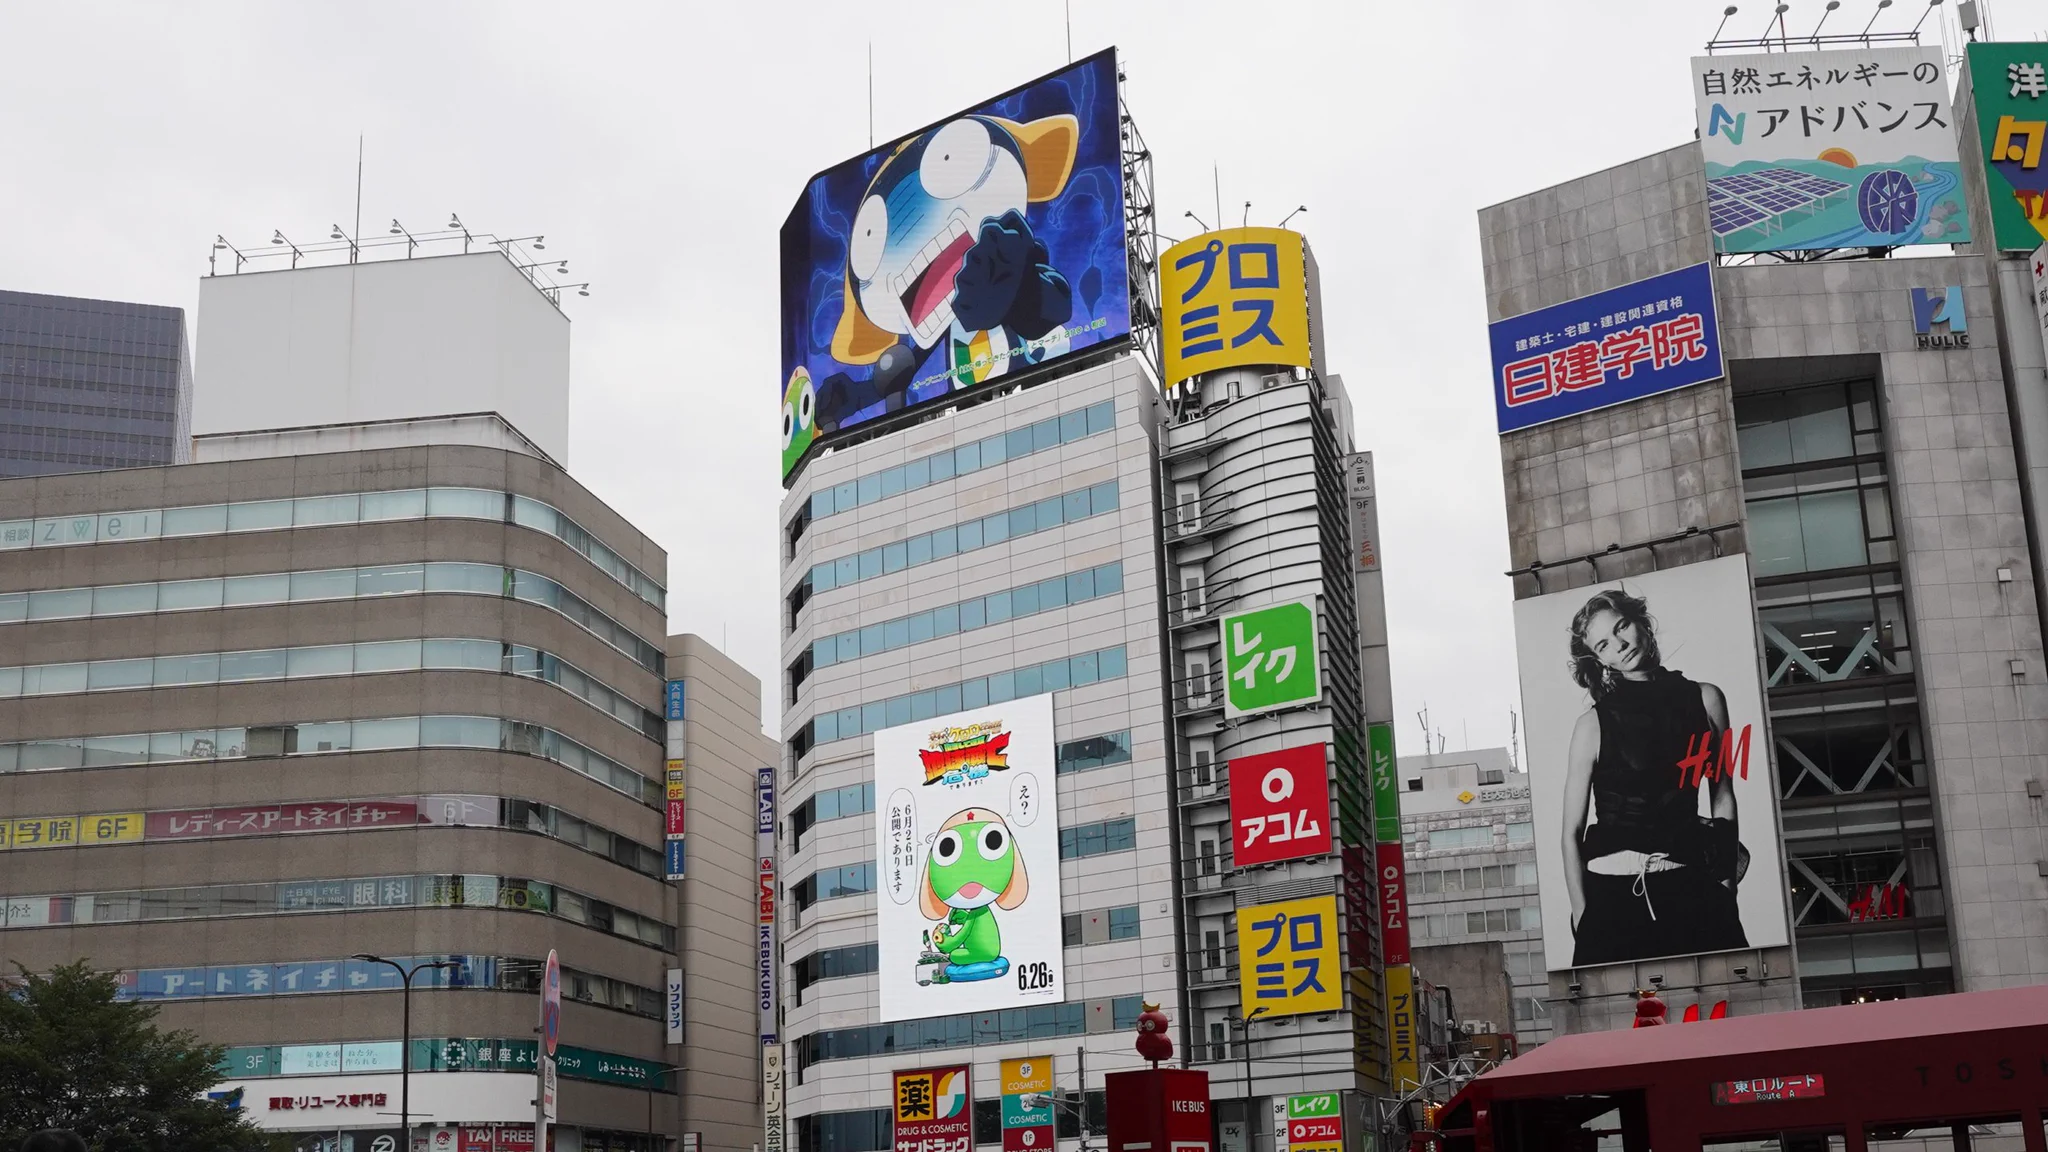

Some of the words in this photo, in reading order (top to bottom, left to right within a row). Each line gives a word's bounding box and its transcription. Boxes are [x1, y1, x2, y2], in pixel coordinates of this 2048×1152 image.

[1702, 62, 1940, 96] 自然エネルギーの
[1757, 100, 1948, 138] アドバンス
[1515, 296, 1683, 352] 建築士・宅建・建設関連資格
[1917, 334, 1970, 350] HULIC
[1503, 312, 1708, 408] 日建学院
[1356, 500, 1369, 510] 9F
[1675, 723, 1752, 790] H&M
[1374, 749, 1391, 791] レイク
[668, 788, 683, 798] 6F
[169, 804, 401, 834] レディースアートネイチャー
[443, 801, 474, 823] 6F
[760, 788, 772, 830] LABI
[96, 817, 128, 839] 6F
[1240, 808, 1322, 849] アコム
[891, 806, 903, 894] 公開であります
[353, 880, 408, 906] 眼科
[760, 873, 774, 924] LABI
[1847, 882, 1906, 922] H&M
[1384, 883, 1403, 930] アコム
[760, 925, 771, 1011] IKEBUKURO
[162, 966, 398, 995] アートネイチャー
[669, 983, 681, 1029] ソフマップ
[1392, 993, 1412, 1063] プロミス
[246, 1055, 264, 1069] 3F
[557, 1055, 581, 1068] クリニック
[1021, 1065, 1031, 1075] 3F
[1008, 1079, 1047, 1091] COSMETIC
[1732, 1074, 1816, 1094] 東口ルート
[268, 1092, 388, 1111] 買取・リユース専門店
[900, 1078, 931, 1118] 薬
[1293, 1096, 1331, 1114] レイク
[1756, 1092, 1782, 1101] Route
[1009, 1113, 1048, 1125] COSMETIC
[1274, 1104, 1285, 1114] 3F
[465, 1128, 493, 1143] TAX
[501, 1128, 535, 1143] FREE
[897, 1126, 919, 1136] DRUG
[921, 1125, 928, 1135] &
[928, 1122, 968, 1134] COSMETIC
[1024, 1133, 1034, 1143] 1F
[1275, 1127, 1287, 1138] 2F
[1308, 1125, 1337, 1137] アコム
